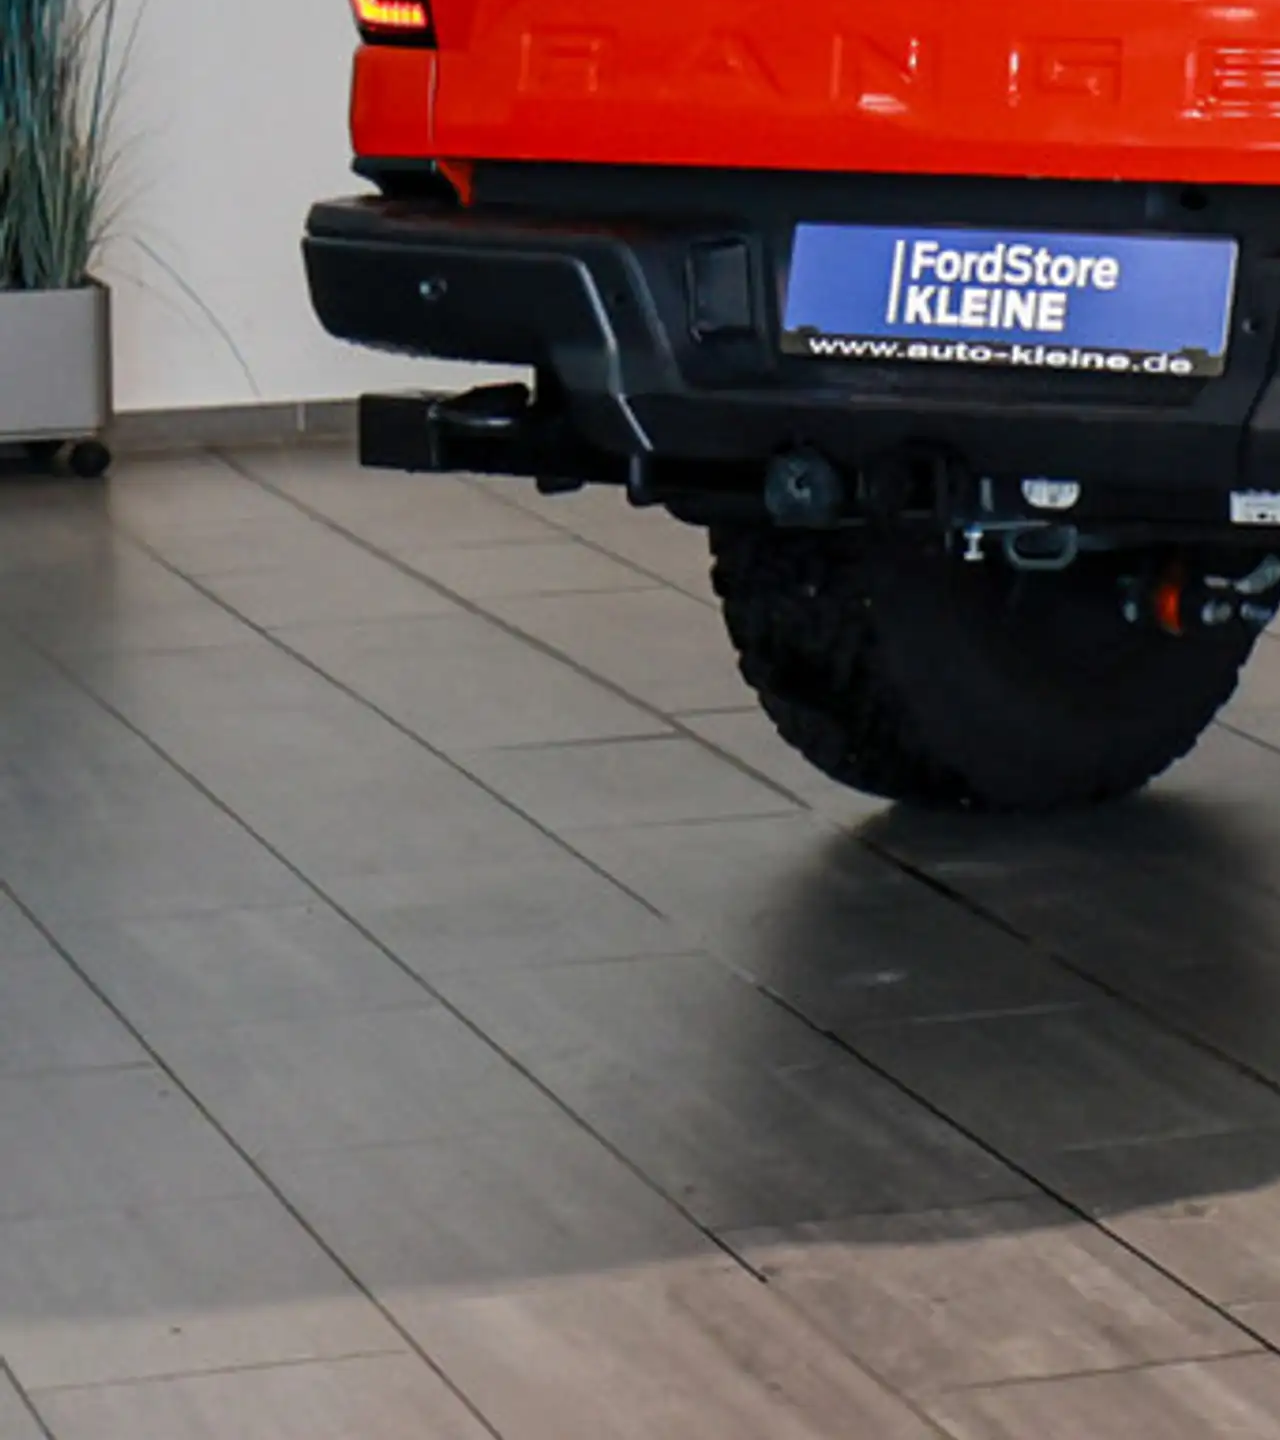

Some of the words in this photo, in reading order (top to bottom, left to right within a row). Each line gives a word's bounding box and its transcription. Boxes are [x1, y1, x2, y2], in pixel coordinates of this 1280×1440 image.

[911, 240, 1120, 290] FordStore
[903, 285, 1068, 331] KLEINE
[807, 334, 1195, 375] www.auto-kleine.de
